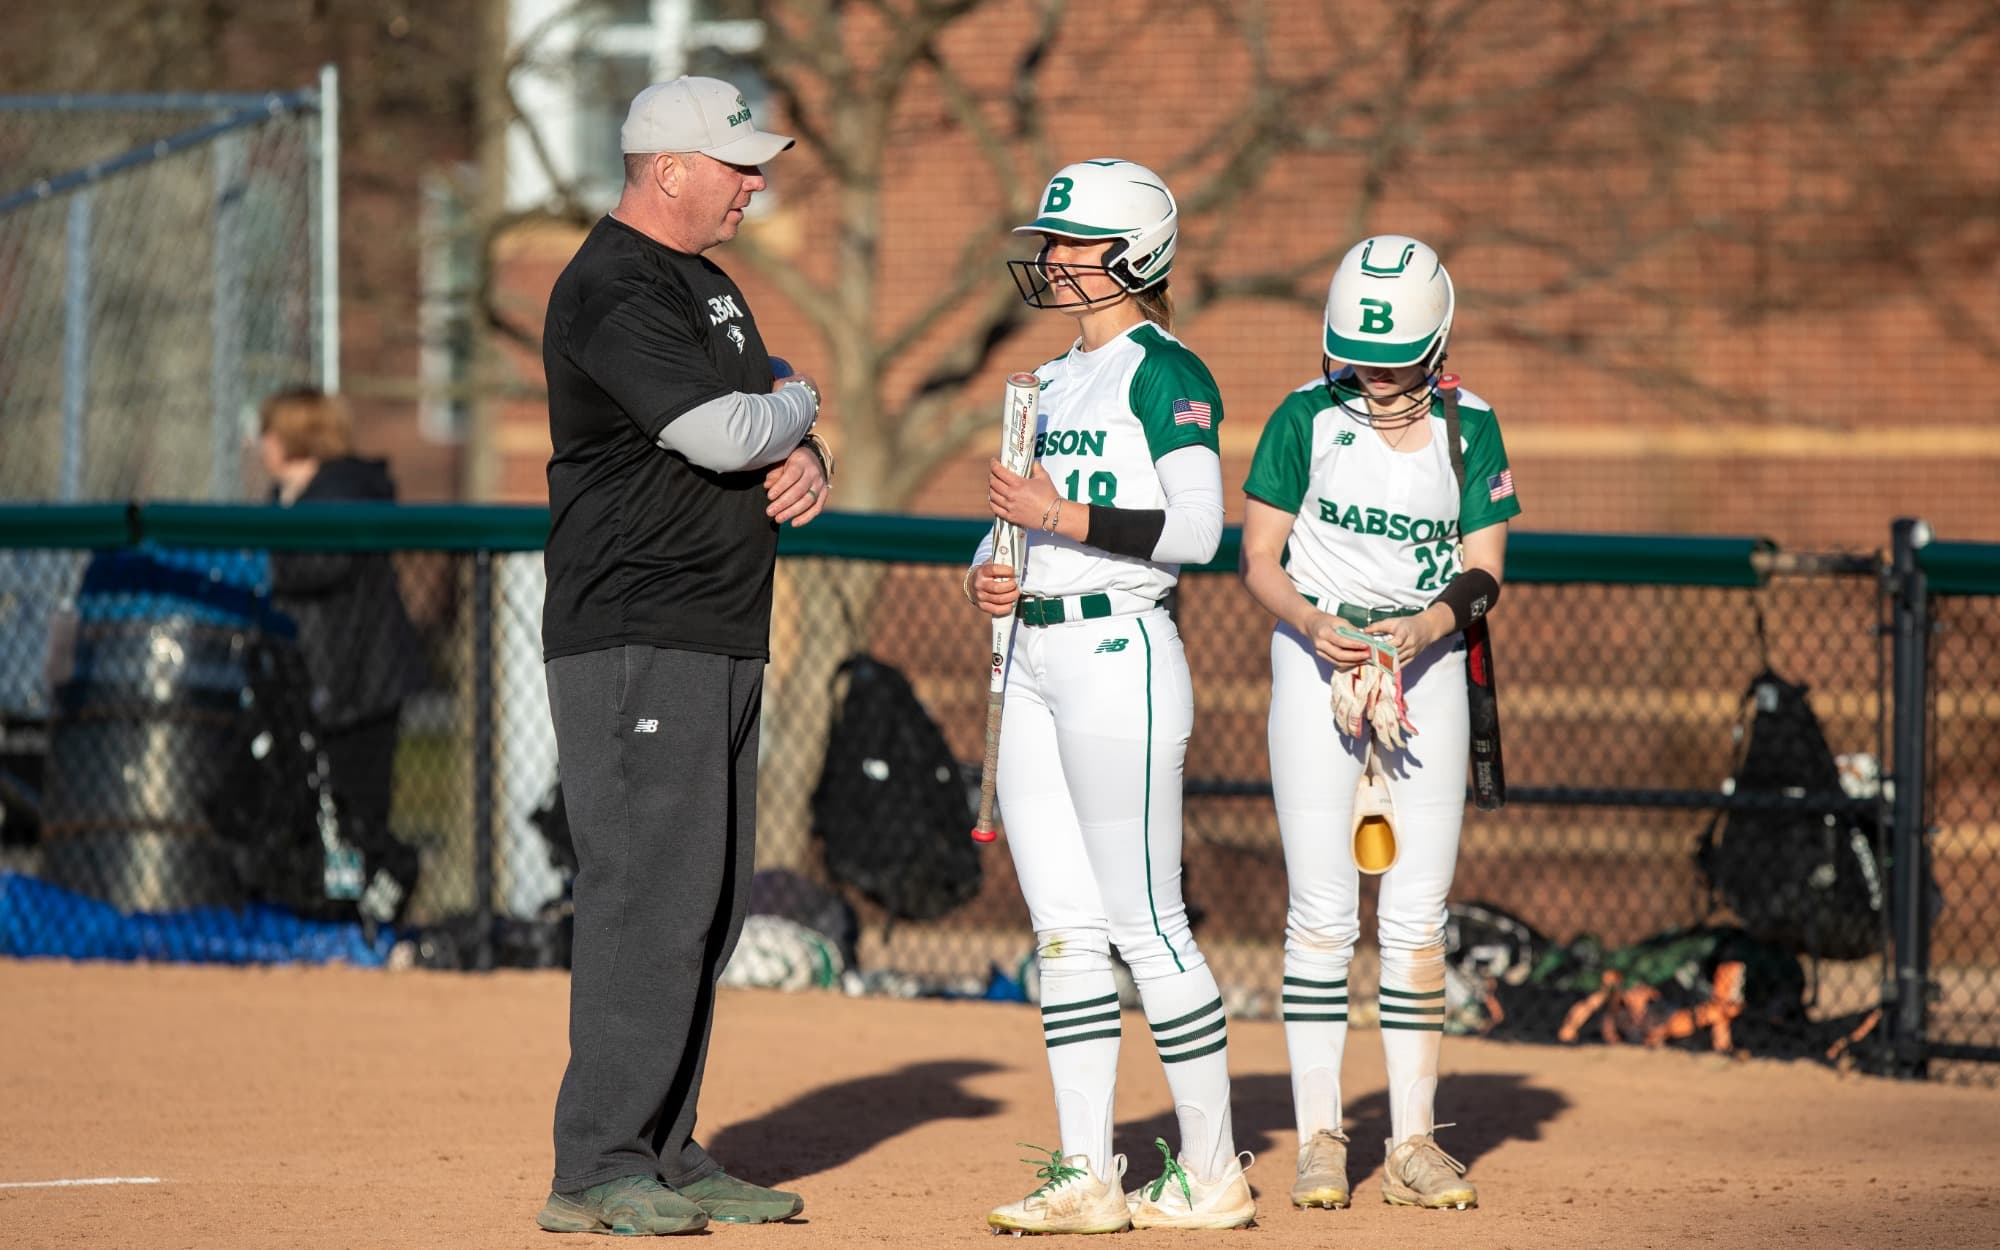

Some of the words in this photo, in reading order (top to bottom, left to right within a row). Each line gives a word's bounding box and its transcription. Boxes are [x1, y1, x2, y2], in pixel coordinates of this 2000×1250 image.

[1044, 177, 1074, 213] B
[1359, 298, 1394, 334] B
[1008, 388, 1024, 470] HOST
[1034, 430, 1107, 457] BSON
[1065, 469, 1118, 508] 18
[1318, 497, 1456, 543] BABSON
[1414, 540, 1461, 591] 22
